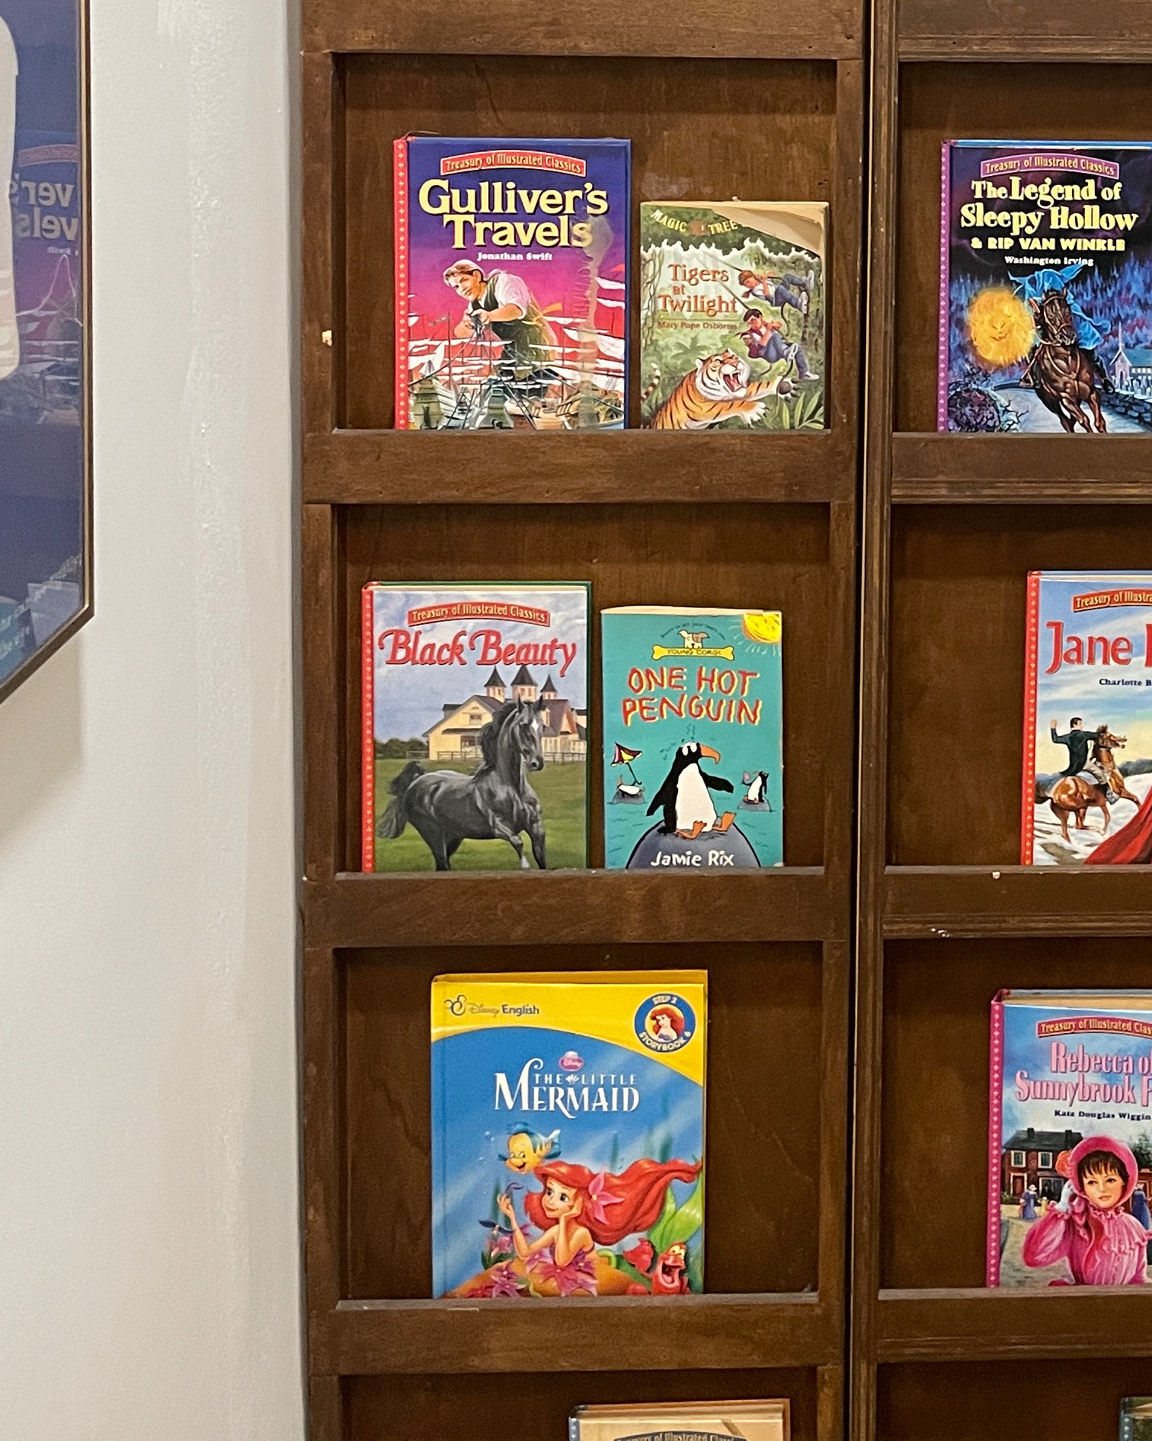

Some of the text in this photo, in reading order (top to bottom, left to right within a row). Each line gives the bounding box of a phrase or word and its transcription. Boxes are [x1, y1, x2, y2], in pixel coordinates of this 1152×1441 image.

[446, 152, 581, 173] Treasury of Illustrated Classics
[418, 179, 609, 216] Gulliver's
[971, 177, 1122, 209] The Legend of
[443, 213, 593, 249] Travels
[960, 203, 1139, 236] Sleepy Hollow
[477, 252, 552, 261] Jonathan Swift
[970, 237, 1126, 251] & RIP VAN WINKLE
[667, 263, 729, 286] Tigers
[657, 294, 738, 317] Twilight
[1076, 594, 1111, 609] Treasury
[1114, 591, 1122, 604] of
[377, 628, 578, 678] Black Beauty
[1044, 620, 1134, 675] Jane
[627, 665, 760, 696] ONE HOT
[621, 694, 763, 727] PENGUIN
[650, 850, 735, 867] Jamie Rix
[1050, 1041, 1133, 1075] Rebecca
[494, 1057, 640, 1118] MERMAID
[533, 1074, 637, 1085] THE LITTLE
[1015, 1070, 1136, 1107] Sunnybrook
